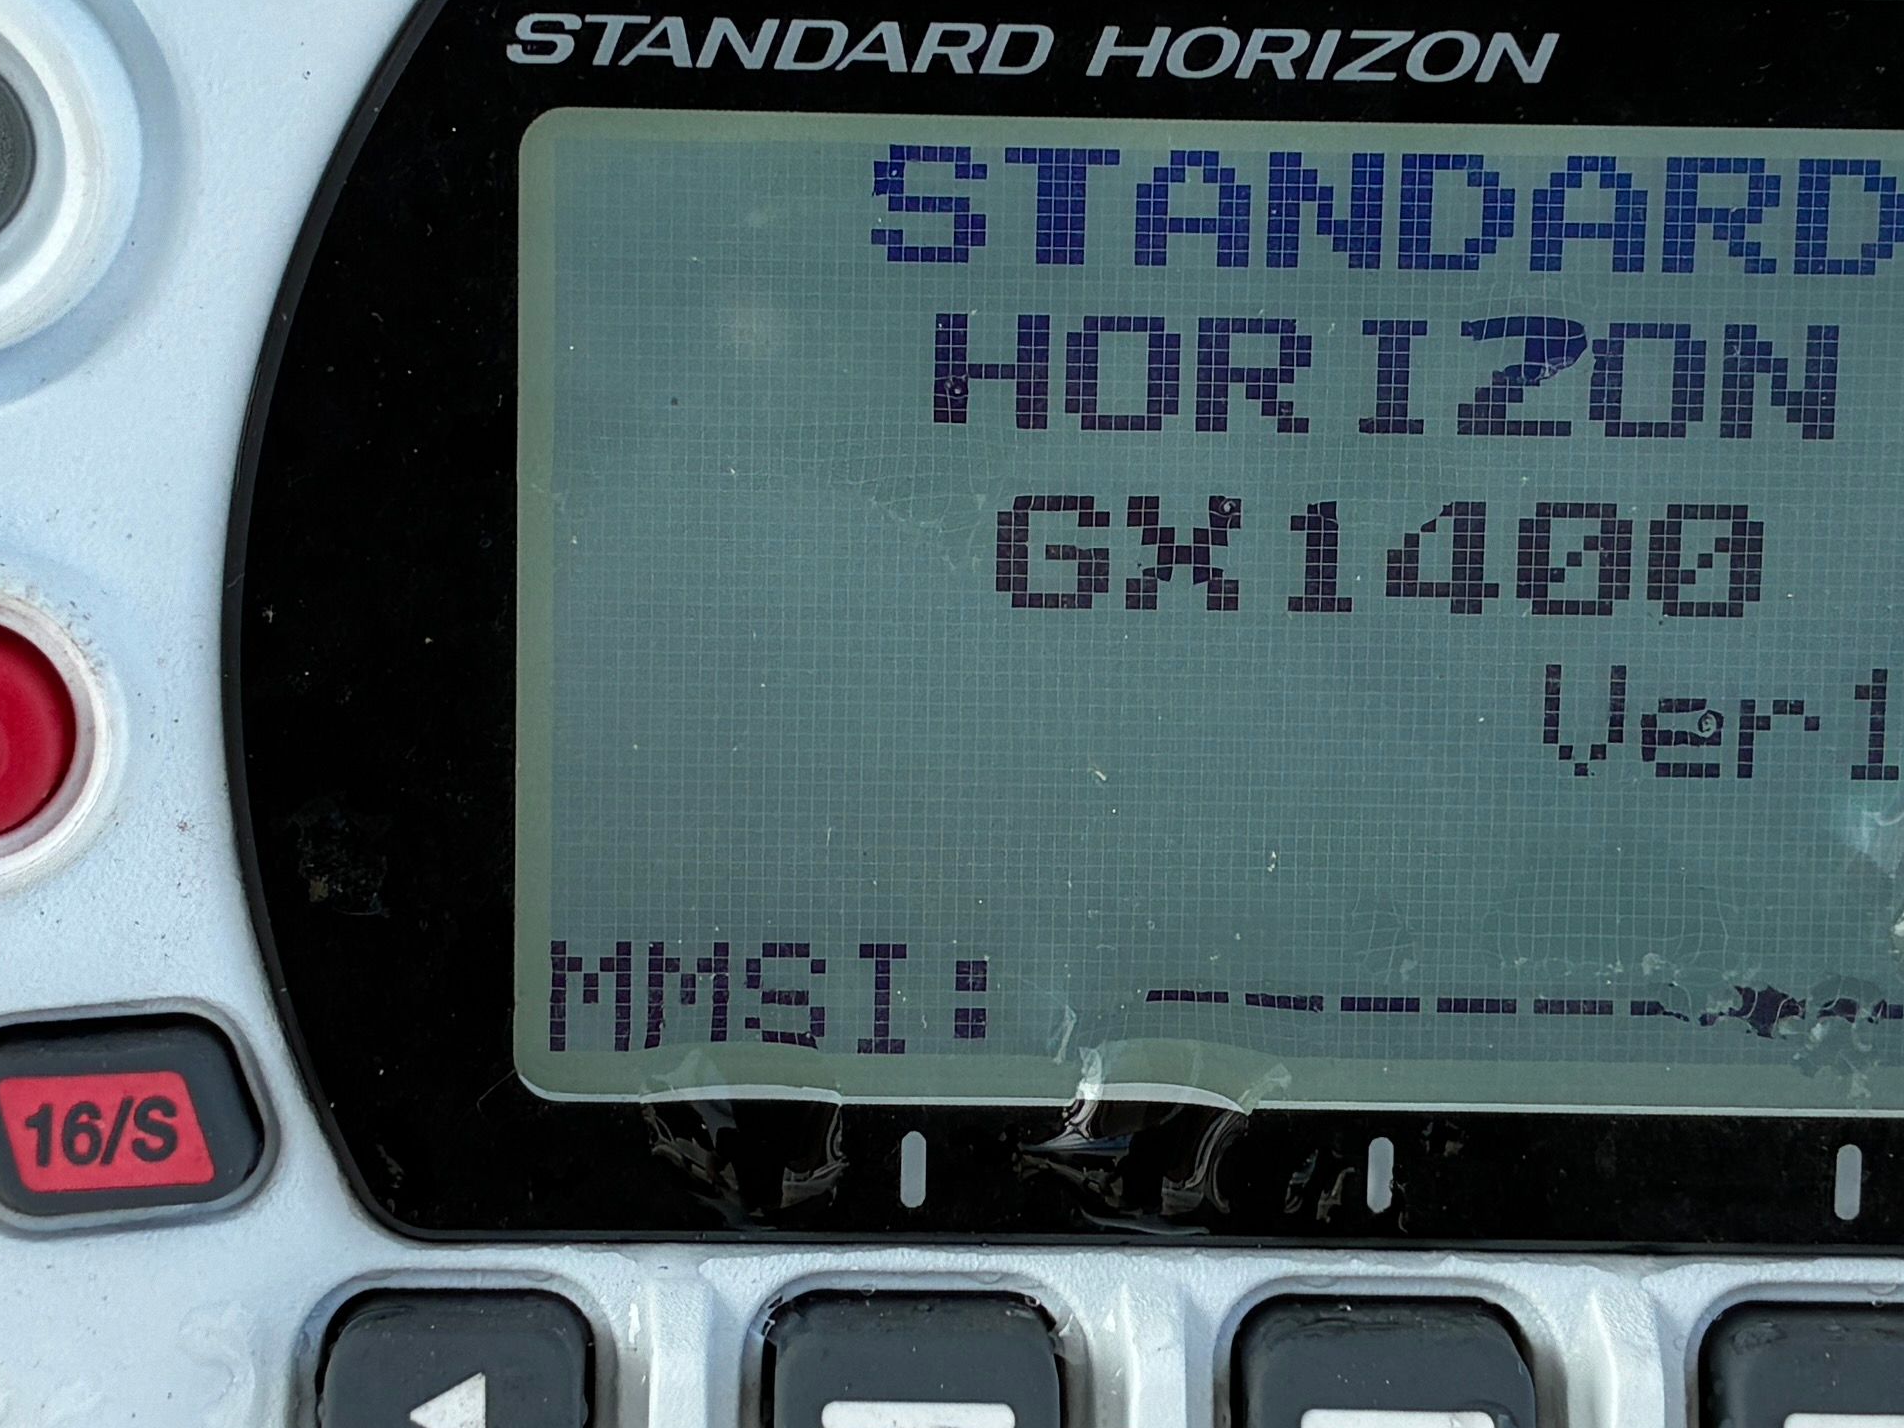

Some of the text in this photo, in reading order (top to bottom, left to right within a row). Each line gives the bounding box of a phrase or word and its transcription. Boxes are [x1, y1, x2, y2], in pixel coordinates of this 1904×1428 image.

[504, 11, 1561, 85] STANDARD HORIZON
[932, 311, 1841, 441] HORIZON
[994, 493, 1766, 619] GX1400
[548, 939, 989, 1056] MMSI:
[23, 1093, 180, 1170] 16/S
